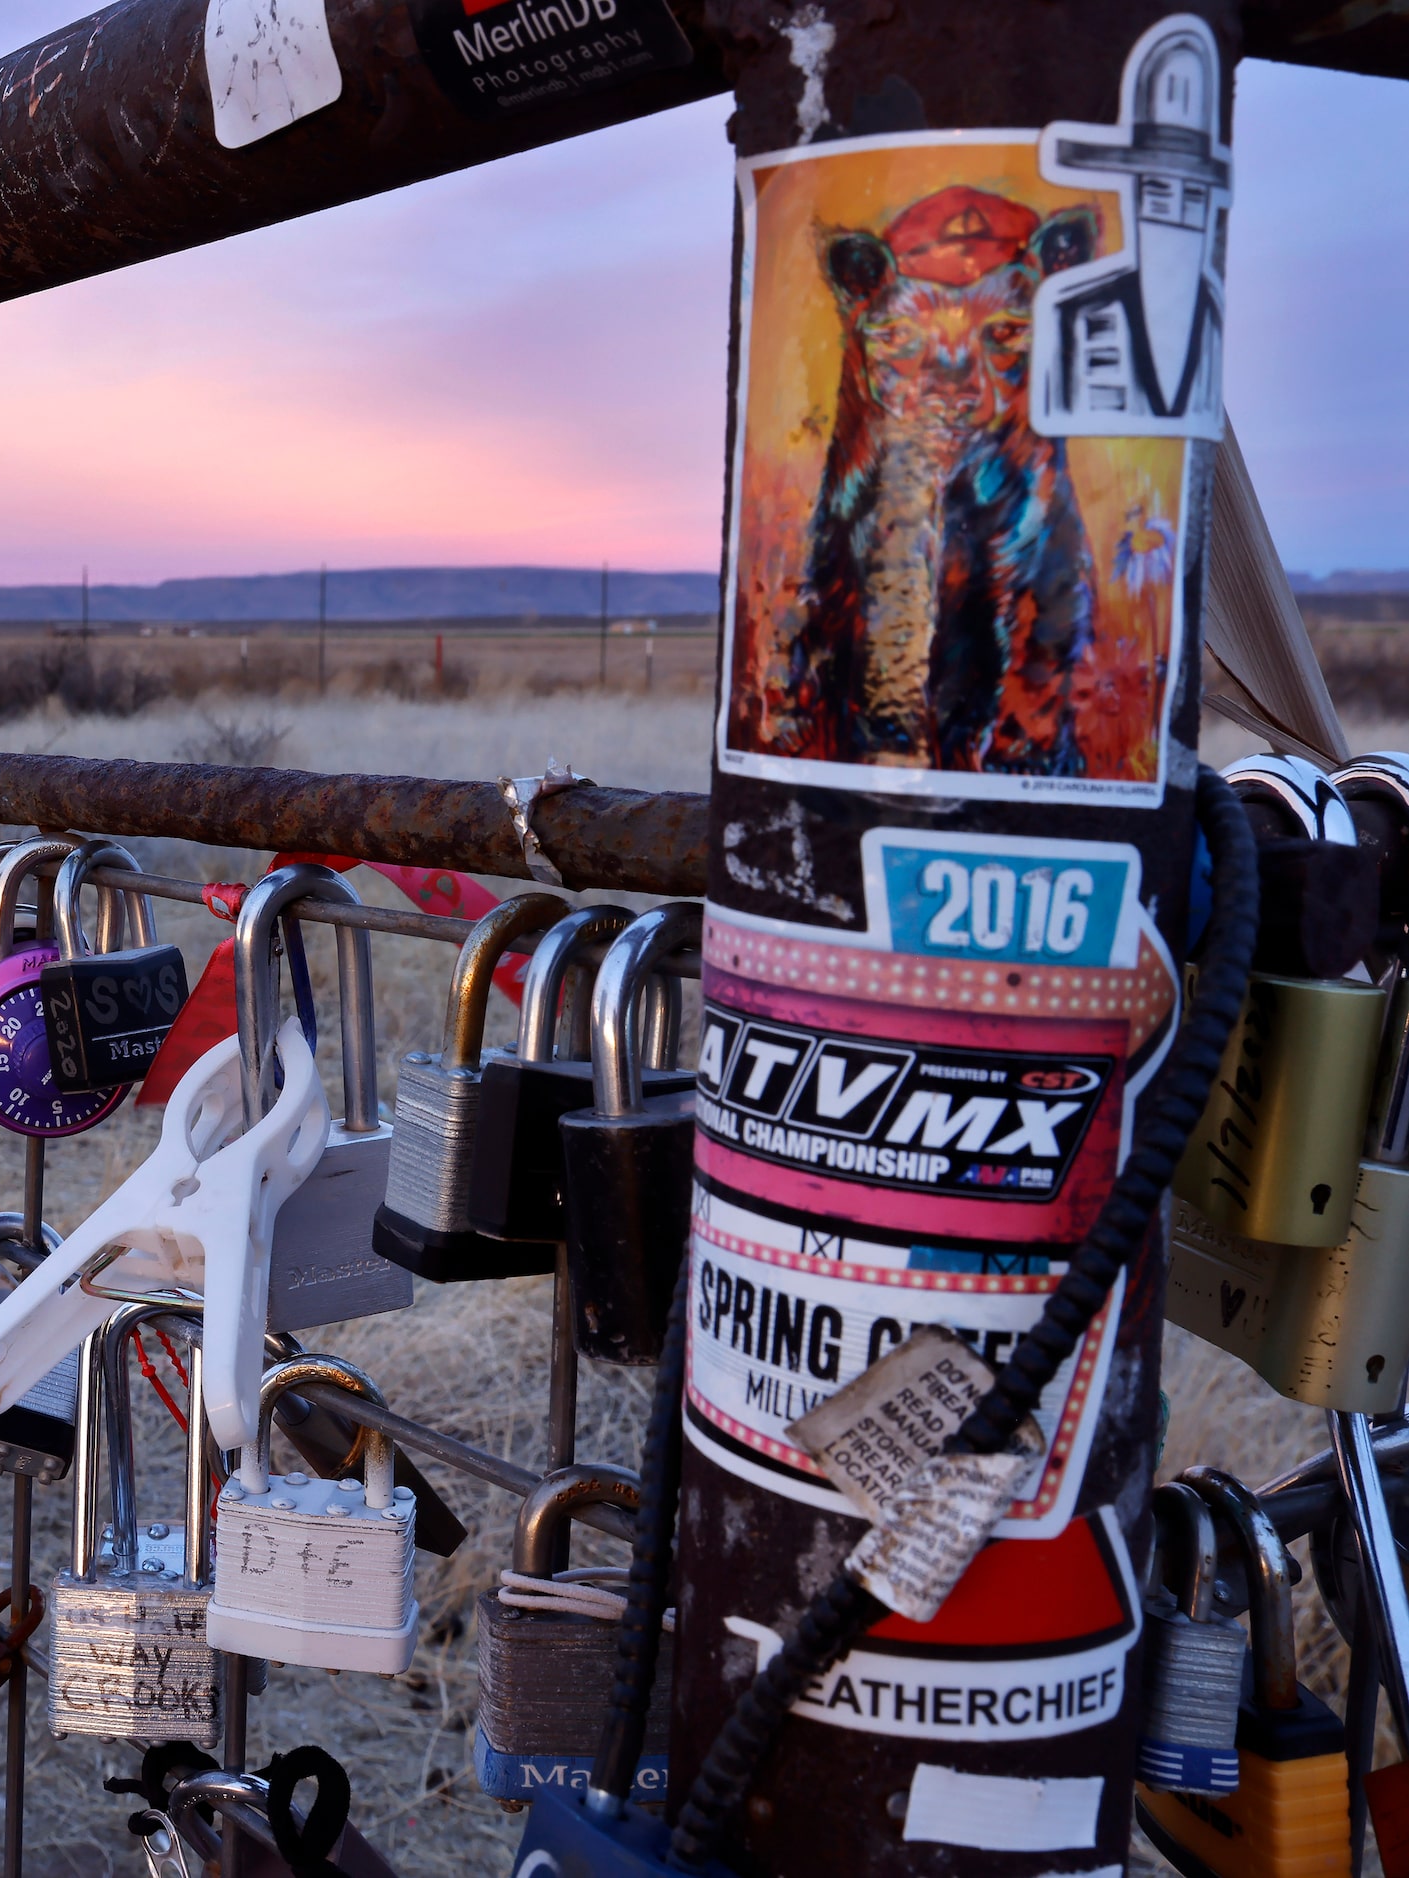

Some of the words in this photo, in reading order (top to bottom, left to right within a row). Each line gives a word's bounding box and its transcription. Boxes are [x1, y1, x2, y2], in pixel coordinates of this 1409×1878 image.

[472, 28, 643, 93] Photography
[919, 859, 1094, 952] 2016
[1, 1016, 23, 1040] 20
[108, 1035, 165, 1061] Mast
[9, 1087, 30, 1107] 10
[920, 1063, 988, 1083] PRESENTED
[990, 1070, 1008, 1084] BY
[1021, 1070, 1082, 1090] CST
[743, 1115, 951, 1184] CHAMPIONSHIP
[287, 1253, 392, 1290] Master
[698, 1259, 843, 1384] SPRING
[896, 1387, 945, 1433] READ
[918, 1371, 969, 1422] FIREA
[857, 1416, 917, 1471] STORE
[882, 1402, 941, 1458] MANUA
[840, 1428, 904, 1490] FIREAR
[798, 1667, 1118, 1727] EATHERCHIEF
[520, 1763, 670, 1790] Maer
